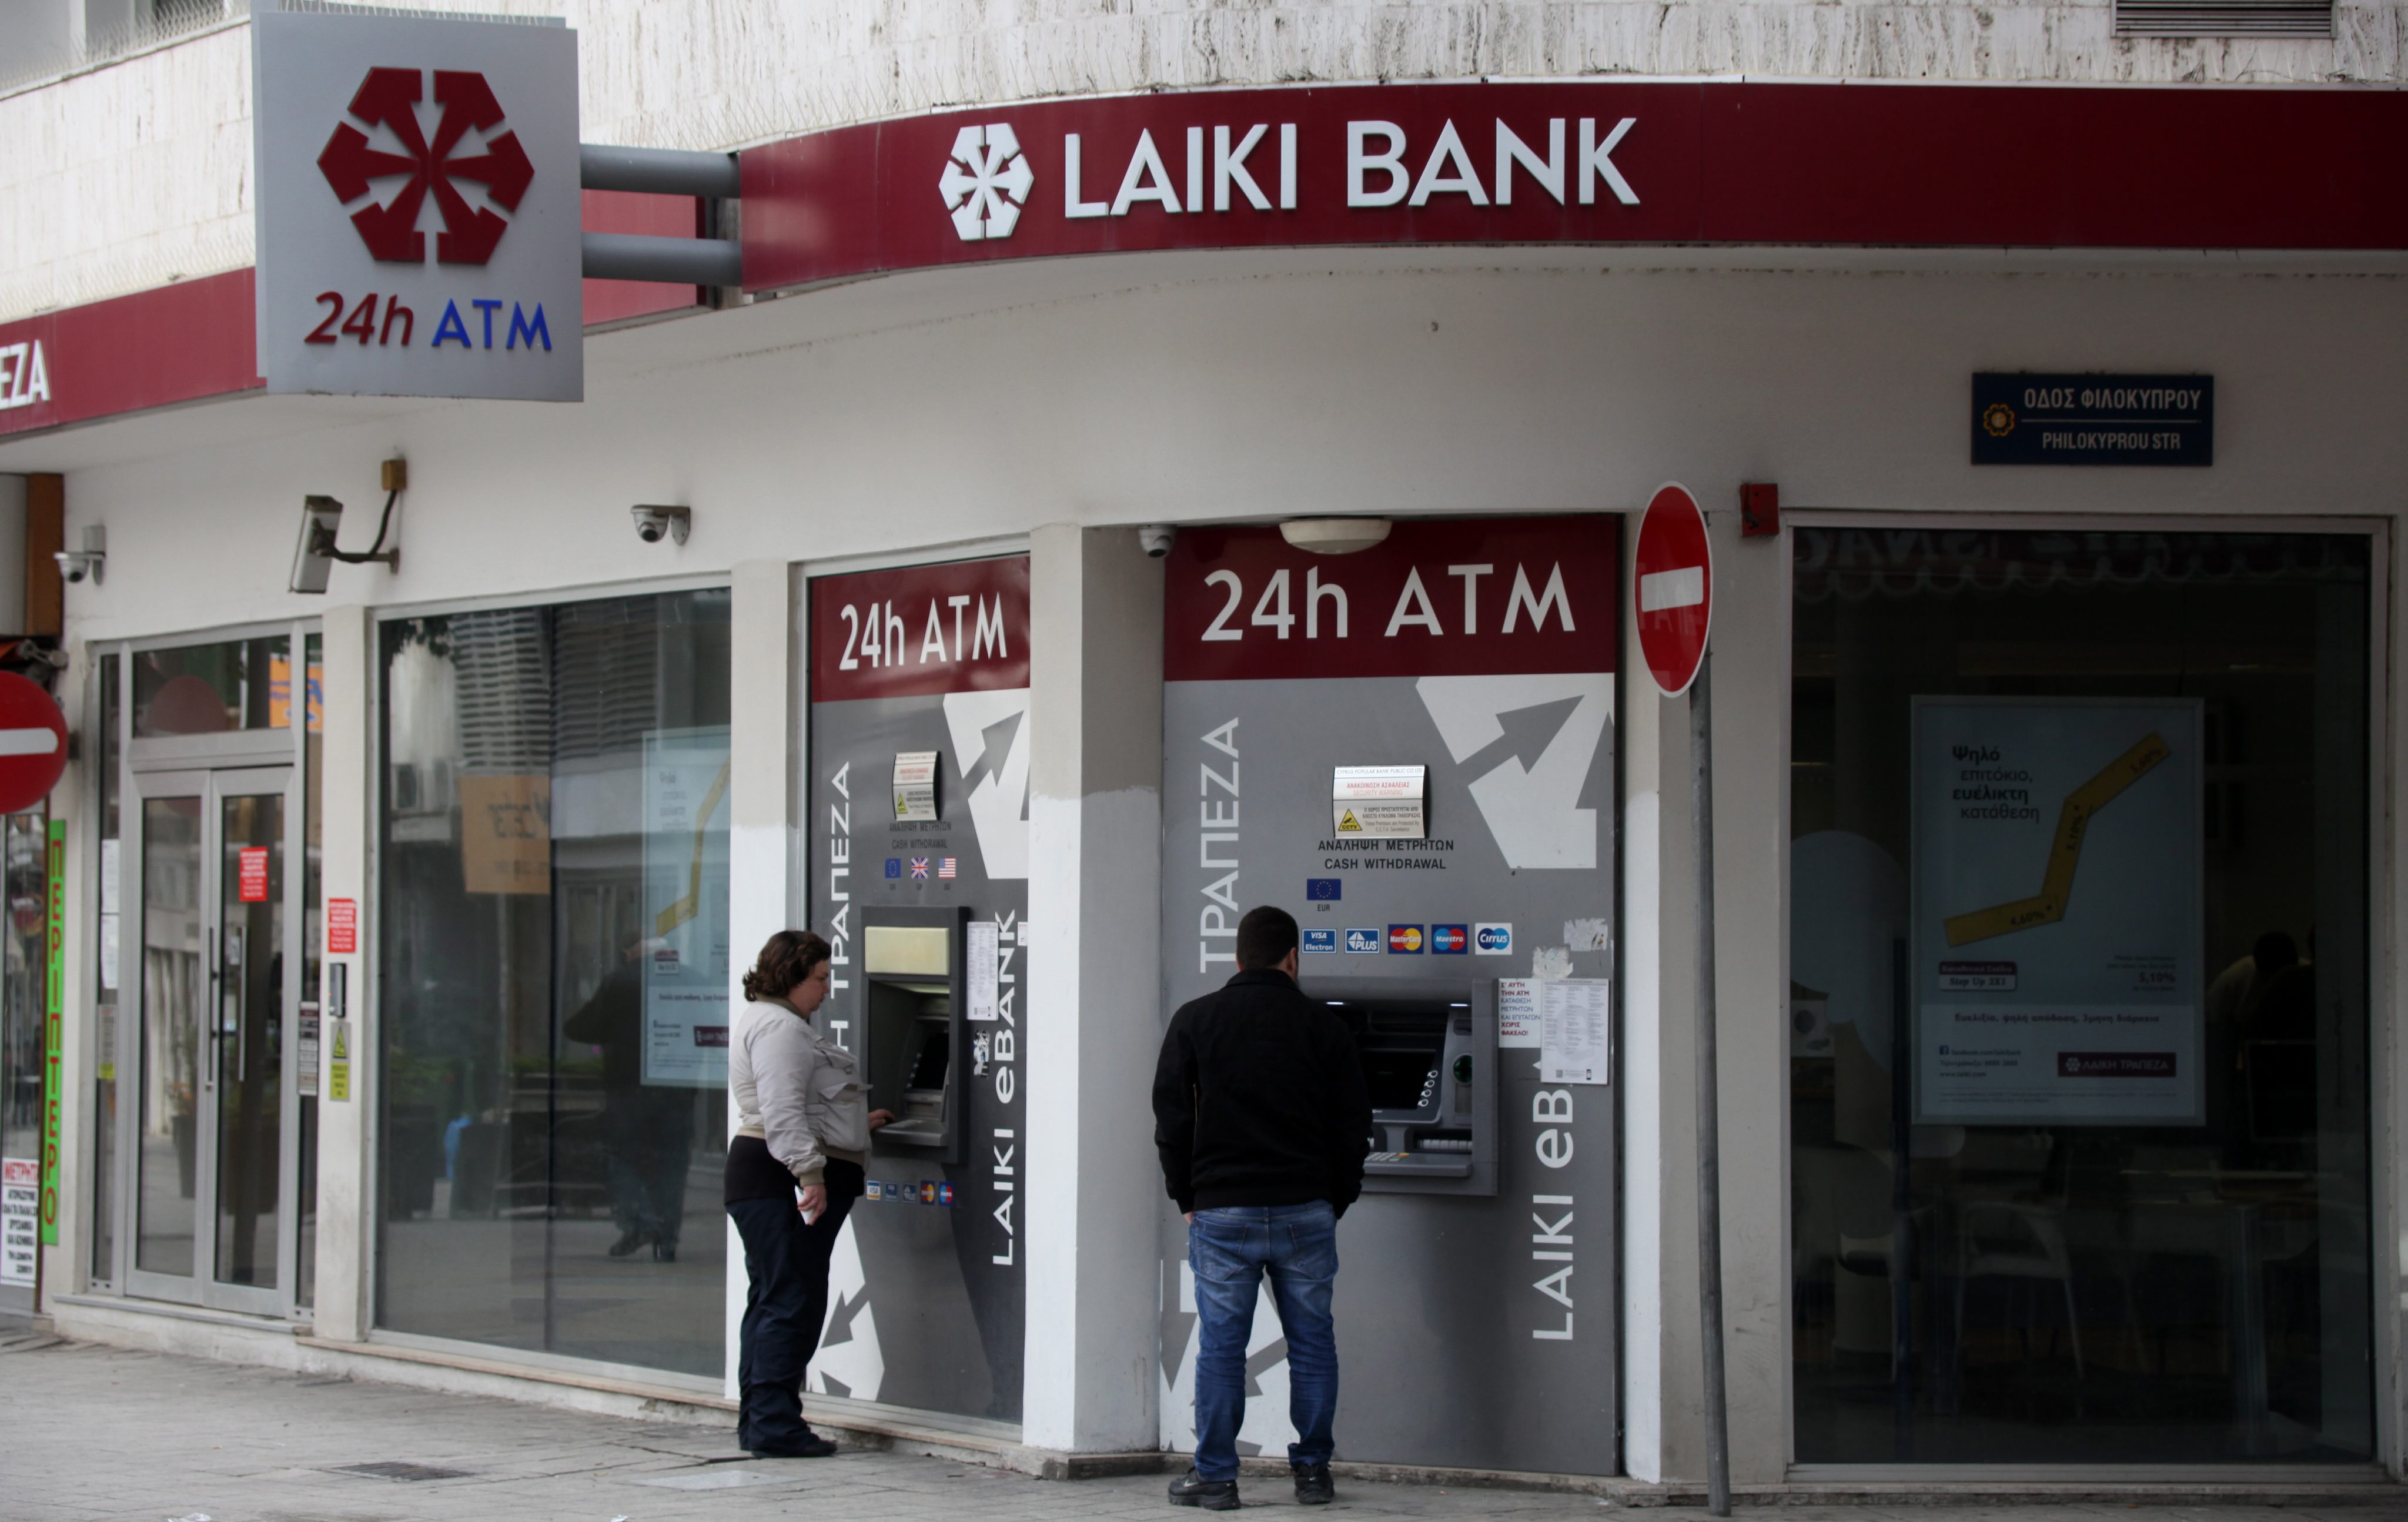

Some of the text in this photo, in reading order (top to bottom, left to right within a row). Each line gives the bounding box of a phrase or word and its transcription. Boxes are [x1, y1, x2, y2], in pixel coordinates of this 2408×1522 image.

[1065, 118, 1641, 218] LAIKI BANK
[304, 292, 552, 350] 24h ATM
[2024, 388, 2202, 410] ΟΔΟΣ ΦΙΛΟΚΥΠΡΟΥ
[2042, 431, 2181, 449] PHILOKYPROU STR
[1201, 560, 1576, 642] 24h ATM
[839, 591, 1008, 671] 24h ATM
[1952, 745, 2000, 765] Ψηλό
[1961, 768, 2032, 784] επιτόκιο,
[1952, 787, 2028, 804] ευέλικτη
[1961, 804, 2040, 823] κατάθεση
[889, 821, 952, 832] ΑΝΑΛΗΨΗ ΜΕΤΡΗΤΩΝ
[892, 839, 948, 850] CASH WITHDRAWAL
[1200, 717, 1239, 974] ΤΡΑΠΕΖΑ
[1318, 839, 1454, 851] ΑΝΑΛΗΨΗ ΜΕΤΡΗΤΩΝ
[1325, 858, 1446, 869] CASH WITHDRAWAL
[831, 761, 849, 999] ΤΡΑΠΕΖΑ
[1305, 943, 1333, 951] Electron
[1356, 940, 1377, 951] PLUS
[1480, 933, 1508, 944] Cirrus
[1949, 978, 1969, 988] Step
[1972, 978, 1985, 988] Up
[2139, 972, 2176, 983] 5,10%
[43, 839, 62, 1227] ΠΕΡΙΠΤΕΡΟ
[2120, 1059, 2169, 1070] ΤΡΑΠΕΖΑ
[993, 909, 1015, 1265] LAIKI eBANK
[1533, 1195, 1573, 1340] LAIKI
